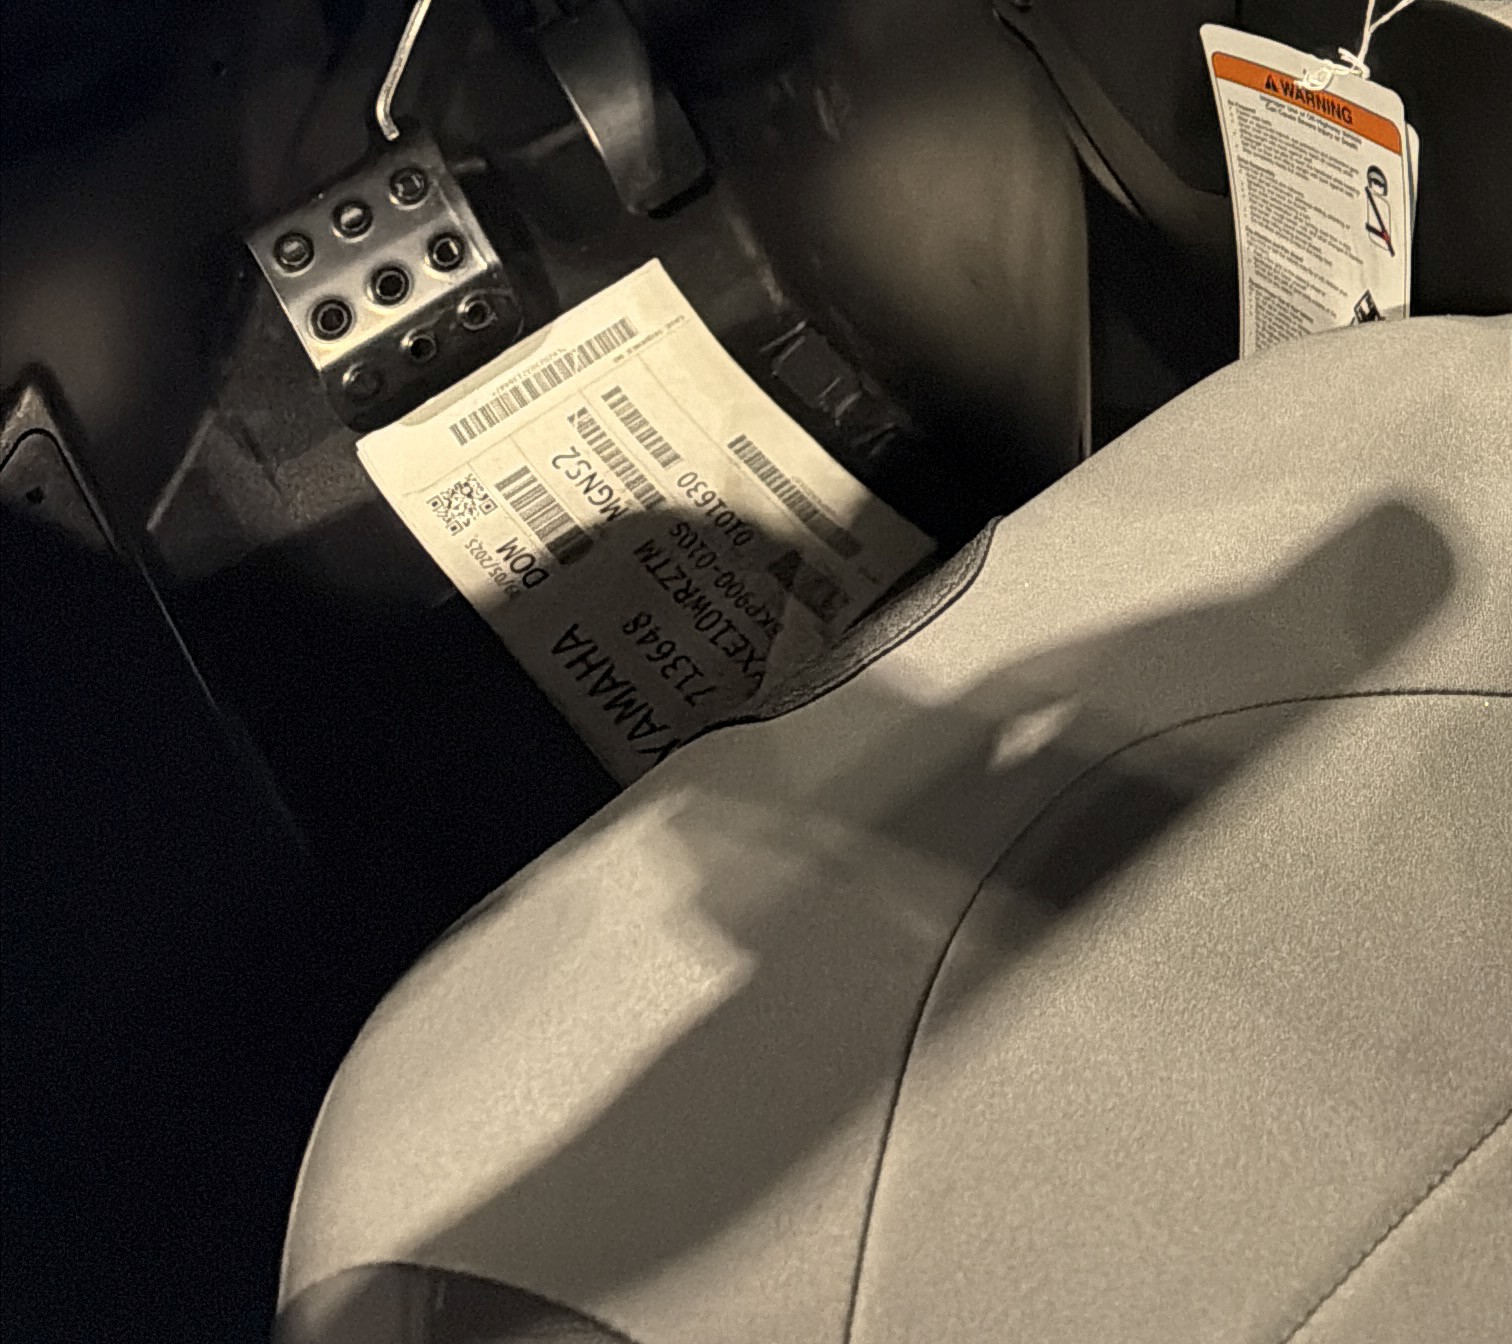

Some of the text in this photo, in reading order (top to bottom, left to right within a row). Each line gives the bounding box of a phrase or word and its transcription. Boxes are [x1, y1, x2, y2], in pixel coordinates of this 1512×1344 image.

[1279, 76, 1355, 126] WARNING
[551, 444, 634, 523] MGNS2
[676, 471, 755, 549] 0101630
[495, 534, 550, 590] DOM
[550, 622, 683, 766] YAMAHA
[620, 610, 718, 708] 713648
